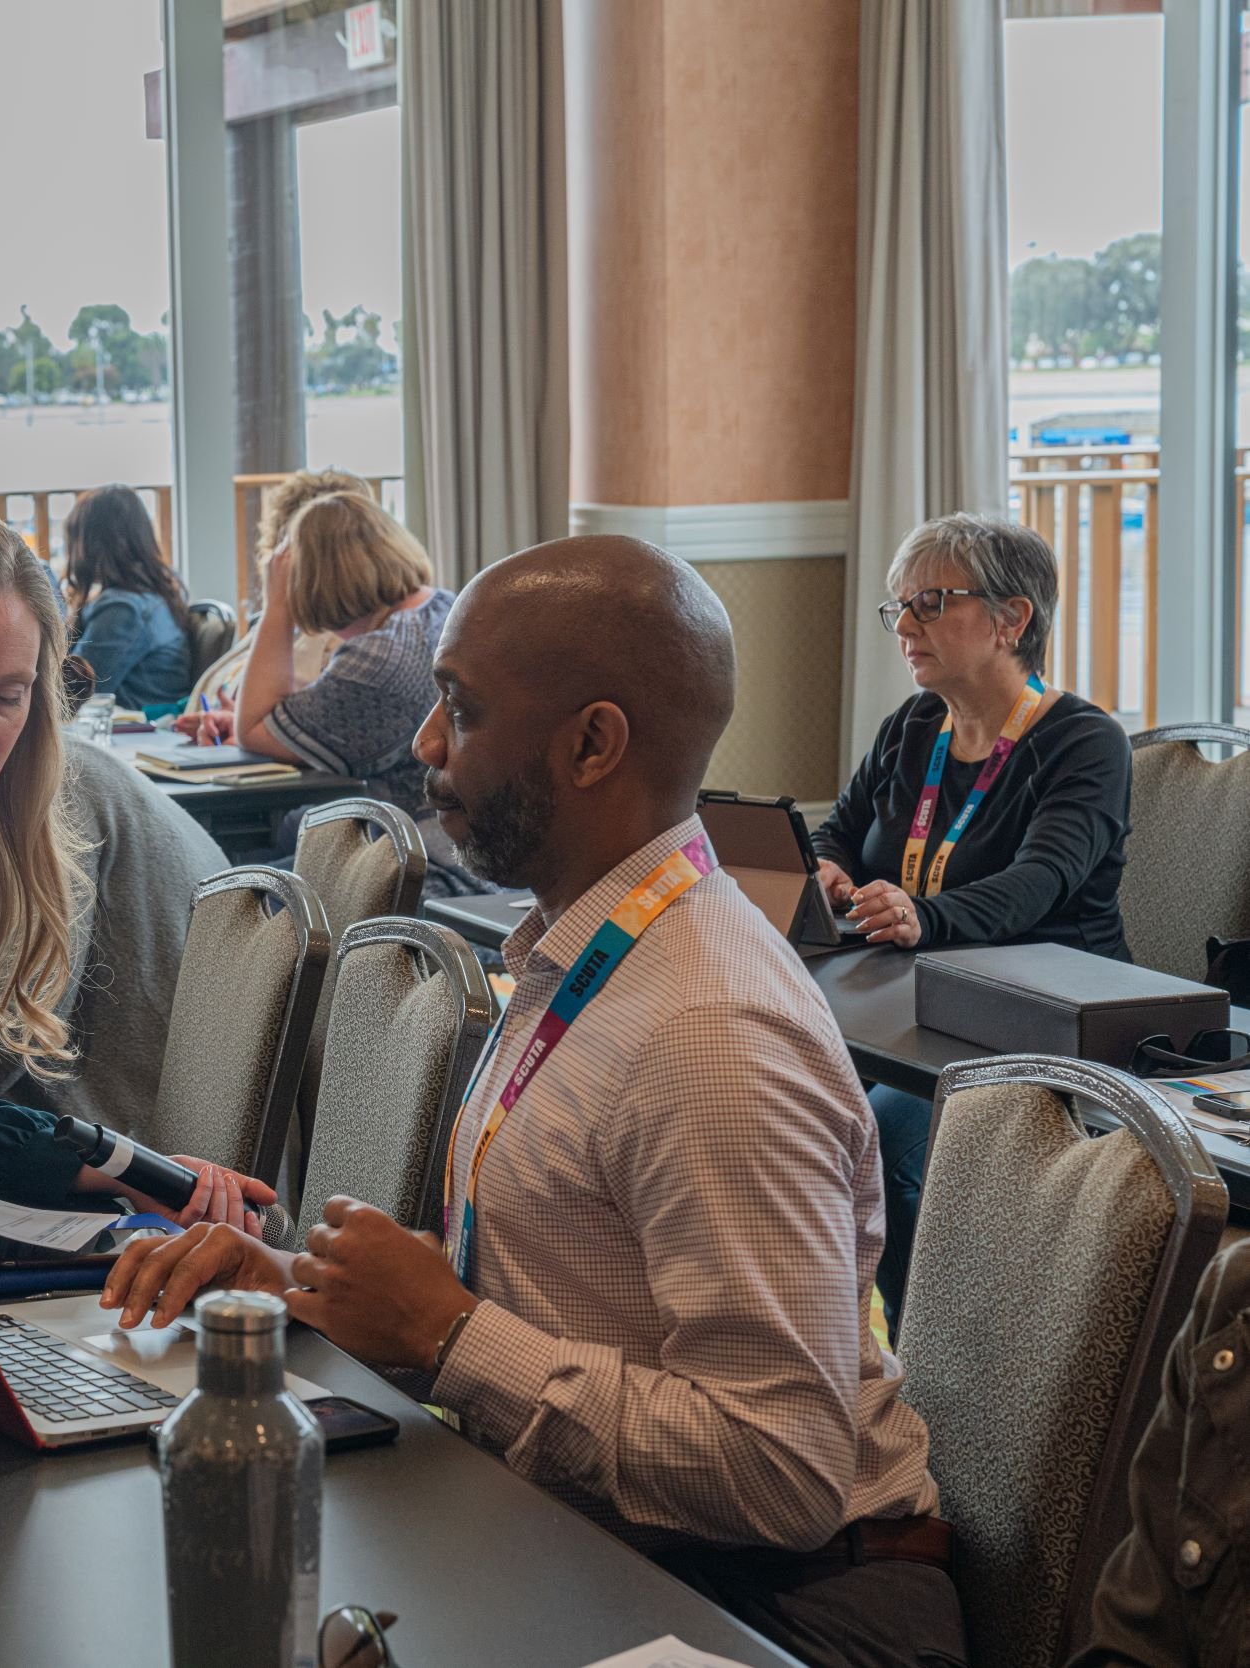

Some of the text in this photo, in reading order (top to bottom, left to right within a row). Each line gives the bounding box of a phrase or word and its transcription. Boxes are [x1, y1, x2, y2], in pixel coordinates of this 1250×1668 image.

[917, 799, 931, 828] SCUTA
[954, 804, 974, 830] SCUTA
[906, 853, 918, 882] SCUTA
[931, 855, 944, 883] SCUTA
[638, 870, 681, 911] SCUTA
[570, 948, 609, 997] SCUTA
[514, 1038, 547, 1087] SCUTA
